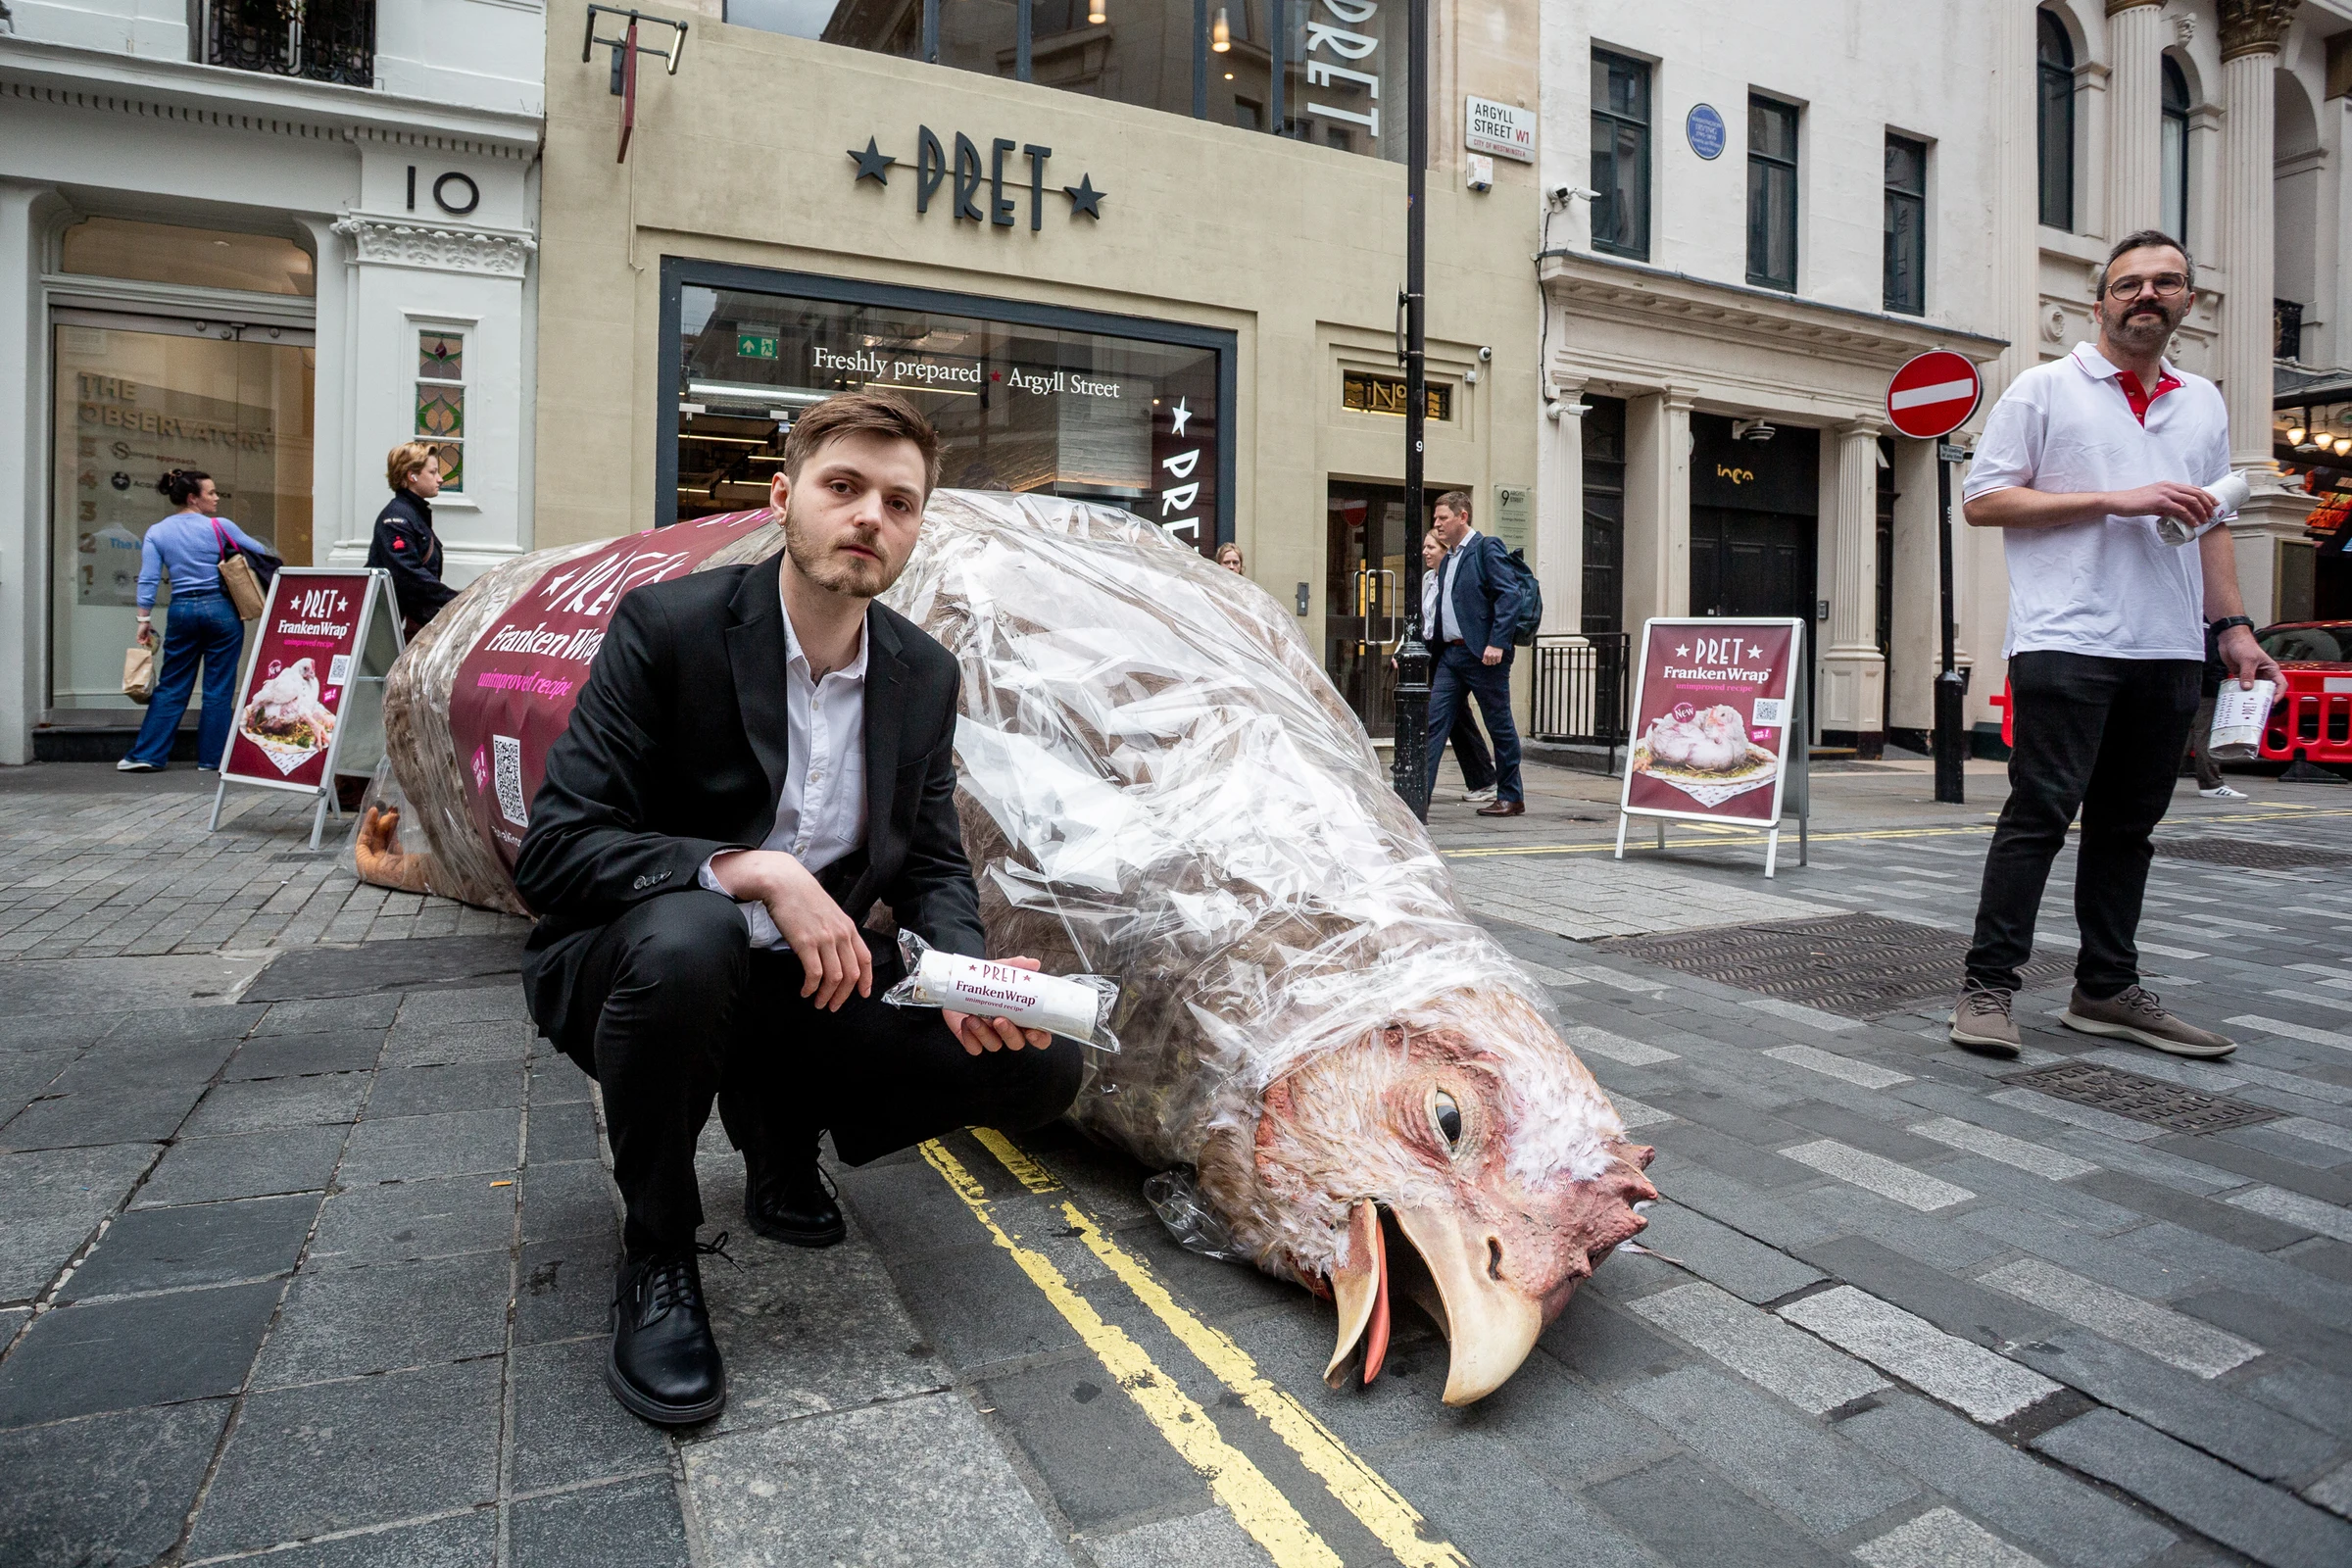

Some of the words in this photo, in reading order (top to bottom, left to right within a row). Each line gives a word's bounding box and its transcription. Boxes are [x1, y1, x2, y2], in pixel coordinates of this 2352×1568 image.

[1307, 0, 1379, 137] PRET
[1474, 103, 1514, 124] ARGYLL
[1474, 119, 1512, 139] STREET
[1515, 128, 1530, 145] W1
[1473, 138, 1485, 147] CITY
[1493, 144, 1526, 158] WESTMINSTER
[407, 165, 480, 215] 10
[917, 123, 1053, 231] PRET
[812, 347, 887, 377] Freshly
[893, 362, 982, 383] prepared
[1007, 368, 1064, 396] Argyll
[1070, 374, 1121, 398] Street
[79, 372, 138, 403] THE
[1416, 440, 1423, 452] 9
[1162, 449, 1200, 555] PRE
[1501, 490, 1510, 507] 9
[300, 589, 339, 619] PRET
[1694, 637, 1744, 665] PRET
[477, 667, 541, 694] unimproved
[531, 676, 573, 700] recipe
[1676, 683, 1726, 692] unimproved
[1674, 708, 1694, 720] New
[982, 963, 1018, 984] PRET
[964, 997, 1004, 1008] unimproved
[1004, 1004, 1024, 1012] recipe
